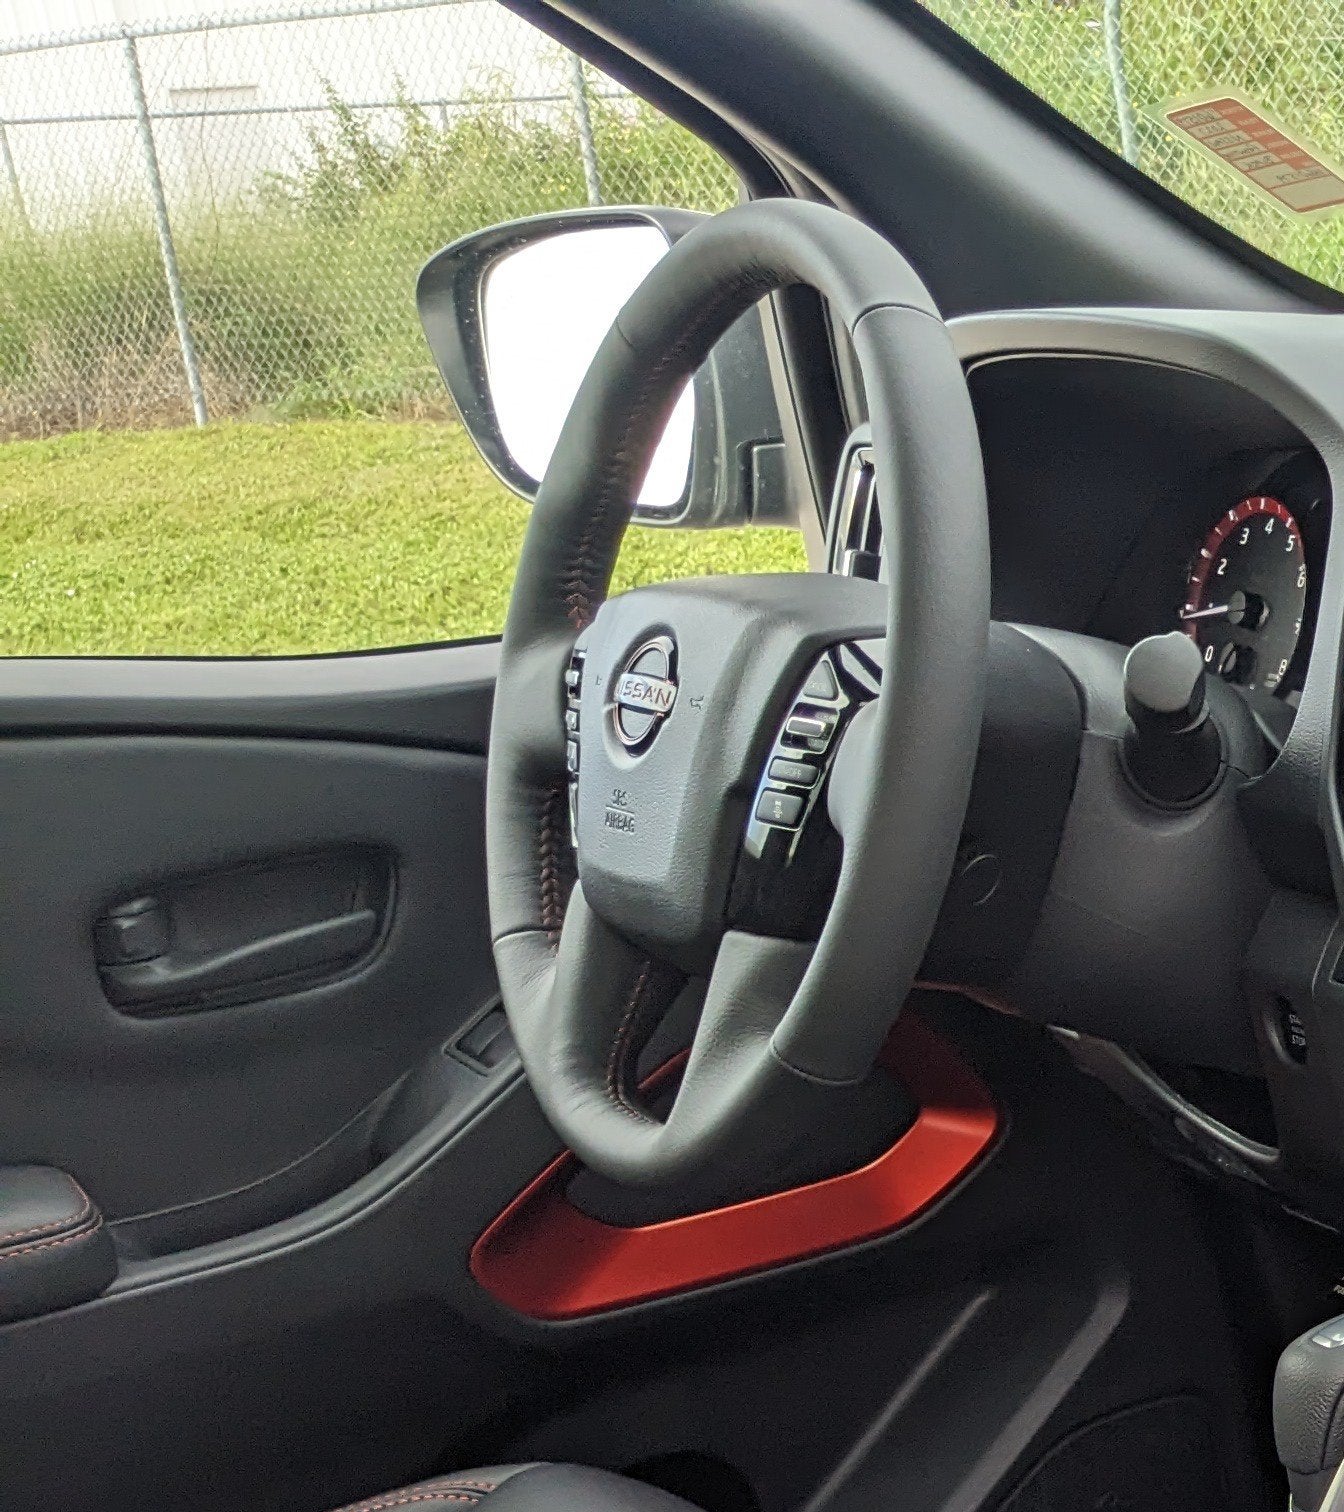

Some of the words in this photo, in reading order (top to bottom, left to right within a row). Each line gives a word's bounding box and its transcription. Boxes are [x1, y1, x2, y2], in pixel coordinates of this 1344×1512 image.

[1264, 518, 1274, 534] 4
[1240, 527, 1249, 545] 3
[1286, 535, 1295, 552] 5
[1217, 558, 1227, 575] 2
[1205, 645, 1213, 662] 0
